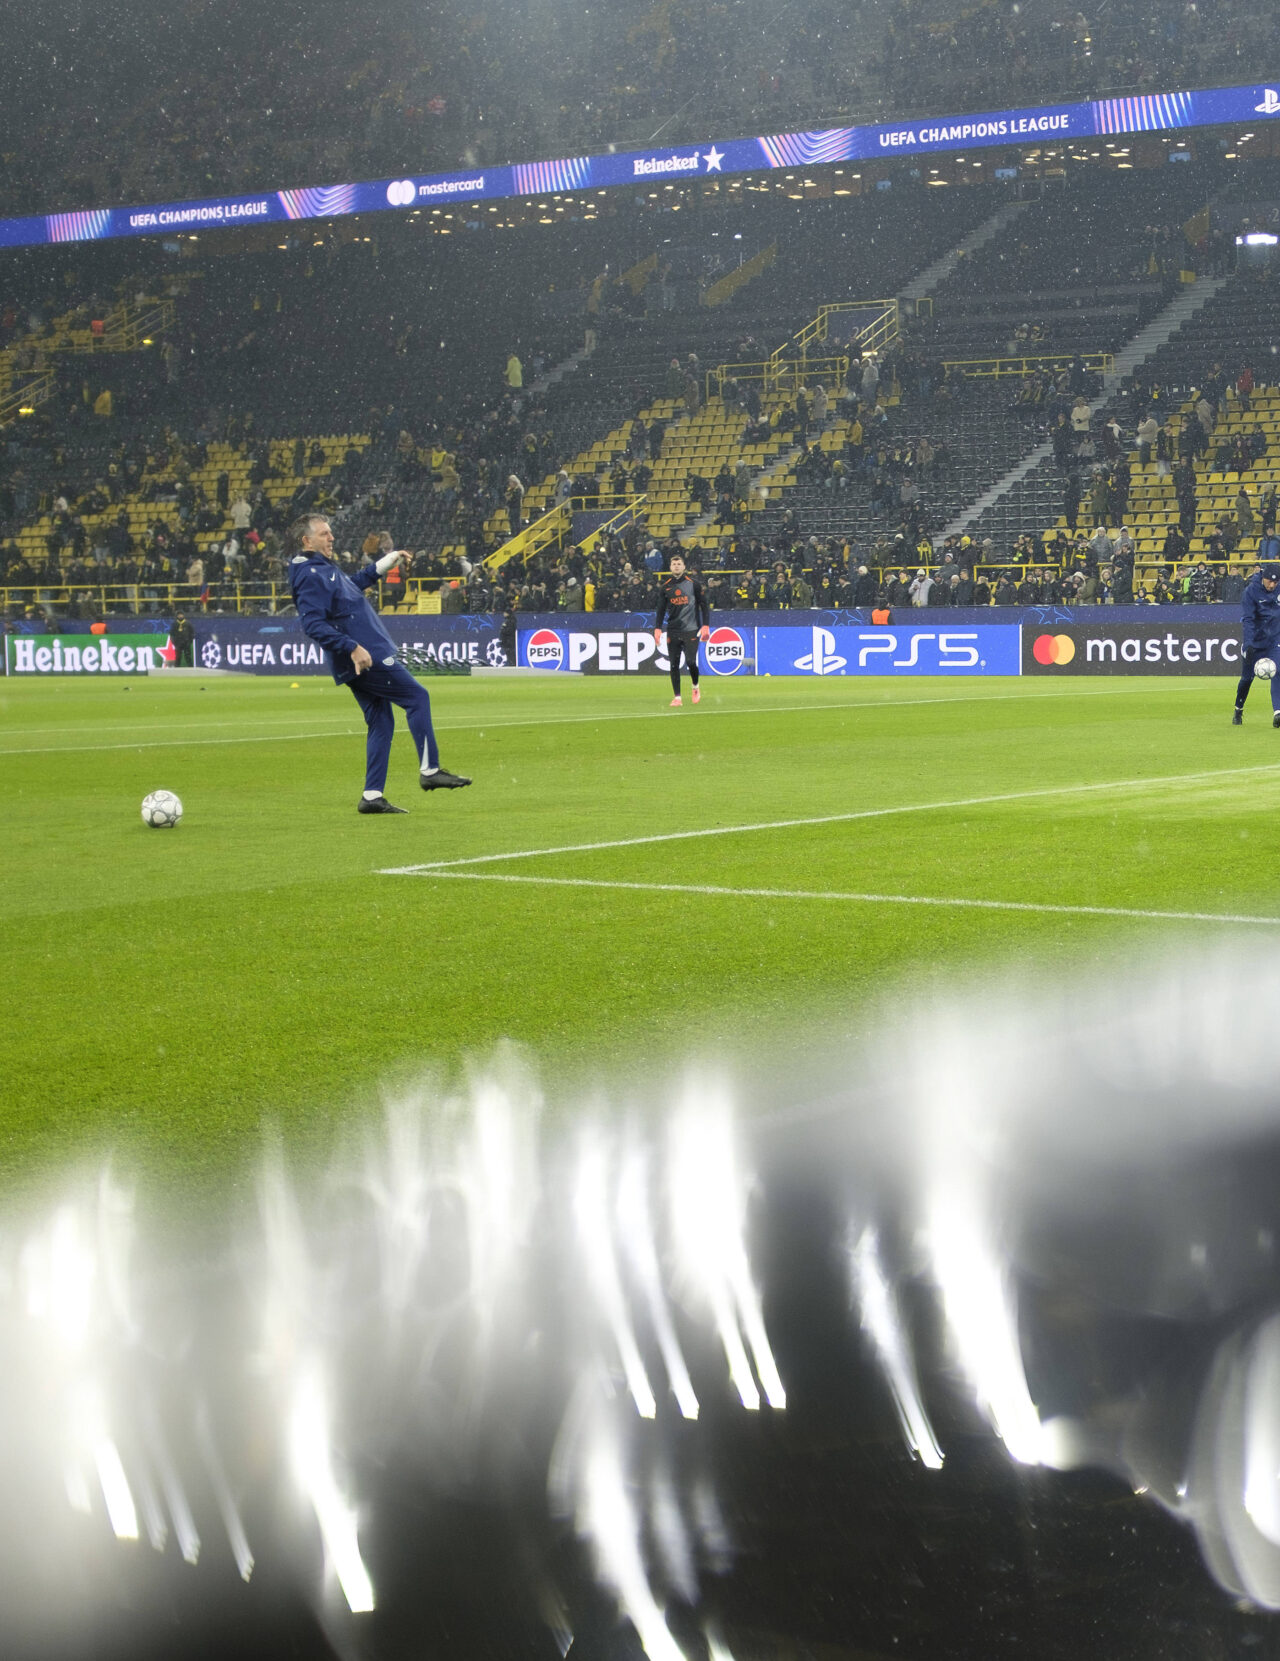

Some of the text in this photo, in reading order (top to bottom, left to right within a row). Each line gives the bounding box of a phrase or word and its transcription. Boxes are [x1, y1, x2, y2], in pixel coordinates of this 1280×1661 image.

[879, 114, 1069, 147] UEFA CHAMPIONS LEAGUE
[633, 154, 699, 175] Heineken
[418, 176, 484, 195] mastercard
[129, 201, 268, 227] UEFA CHAMPIONS LEAGUE
[14, 638, 156, 672] Heineken
[226, 643, 276, 665] UEFA
[529, 647, 561, 657] PEPSI
[568, 632, 699, 672] PEPS
[708, 646, 742, 656] PEPSI
[858, 633, 980, 666] PS5
